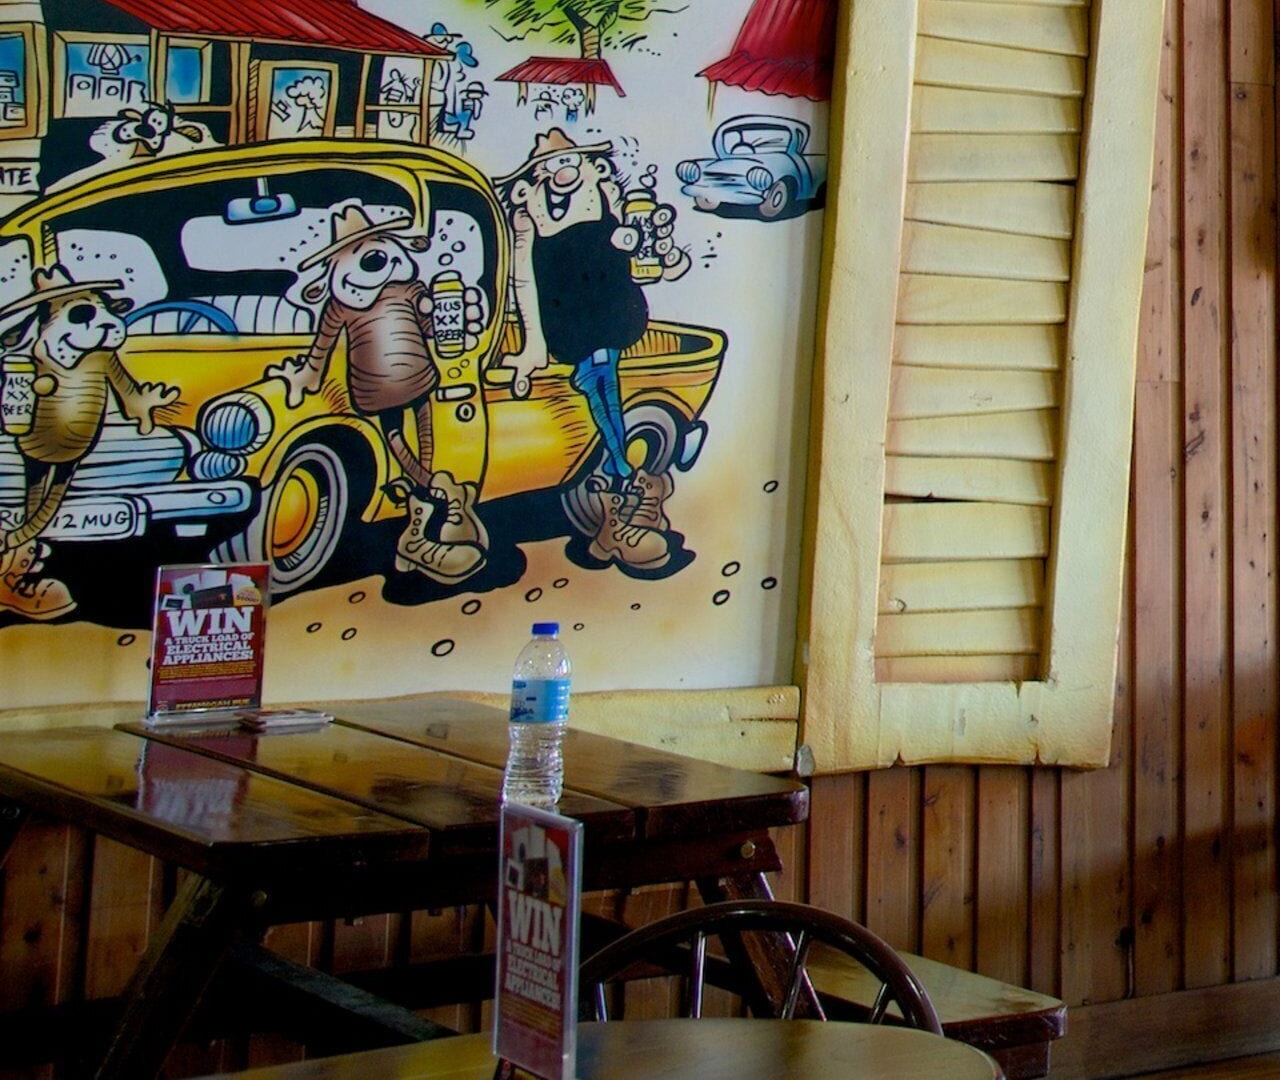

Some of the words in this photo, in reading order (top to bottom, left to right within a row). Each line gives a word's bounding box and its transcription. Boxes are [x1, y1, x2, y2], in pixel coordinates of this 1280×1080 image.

[435, 300, 462, 313] AUS
[436, 329, 464, 342] BEER
[82, 511, 130, 529] MUG
[167, 606, 255, 637] WIN
[164, 638, 174, 646] A
[175, 636, 210, 645] TRUCK
[211, 633, 239, 642] LOAD
[240, 632, 255, 641] OF
[166, 641, 252, 656] ELECTRICAL
[162, 650, 254, 666] APPLIANCES!
[507, 889, 563, 957] WIN
